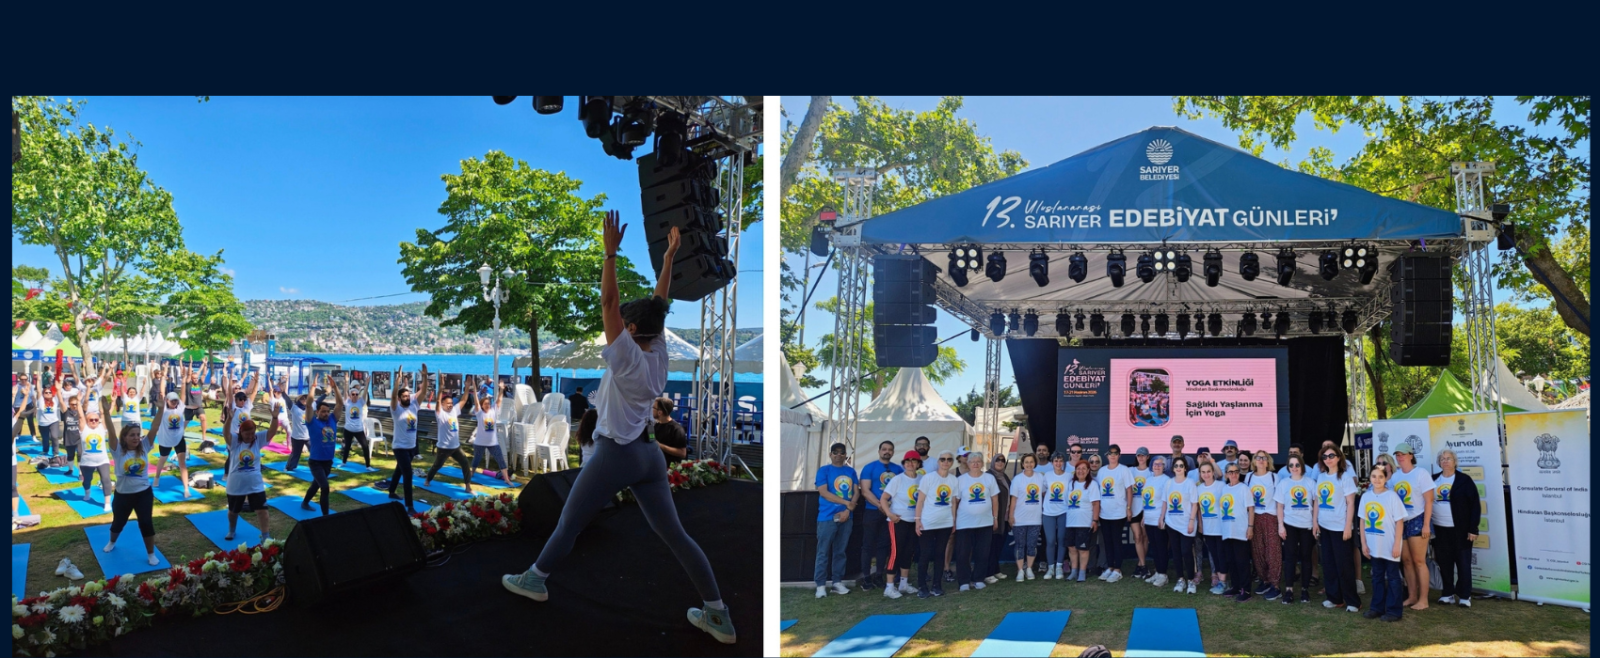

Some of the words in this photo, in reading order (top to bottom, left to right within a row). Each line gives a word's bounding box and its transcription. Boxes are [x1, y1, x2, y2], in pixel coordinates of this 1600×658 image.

[1139, 165, 1180, 174] SARIYER
[981, 195, 1022, 229] 13.
[1024, 214, 1102, 229] SARIYER
[1186, 401, 1218, 409] Sağlıklı
[1220, 401, 1263, 409] Yaşlanma
[1445, 439, 1483, 449] Ayurveda
